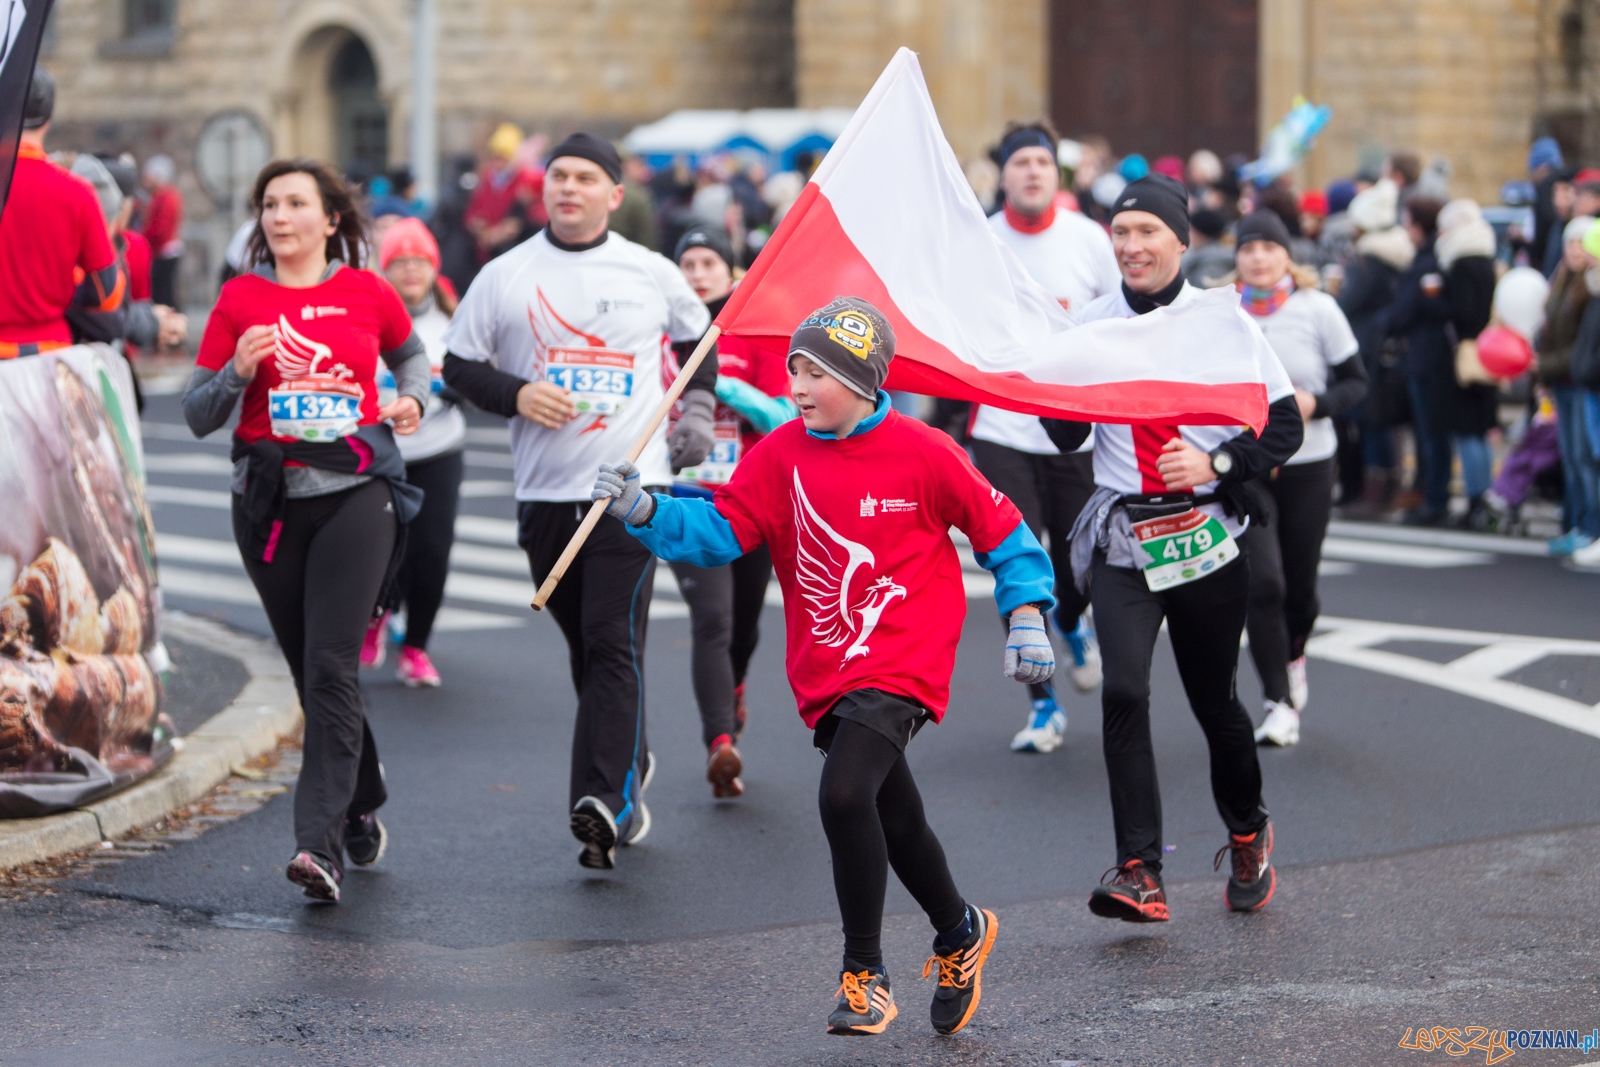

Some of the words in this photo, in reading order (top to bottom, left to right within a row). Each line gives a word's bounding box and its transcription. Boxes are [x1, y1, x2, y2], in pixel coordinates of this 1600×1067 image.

[559, 369, 625, 392] 1325
[284, 395, 352, 419] 1324
[1162, 528, 1213, 560] 479
